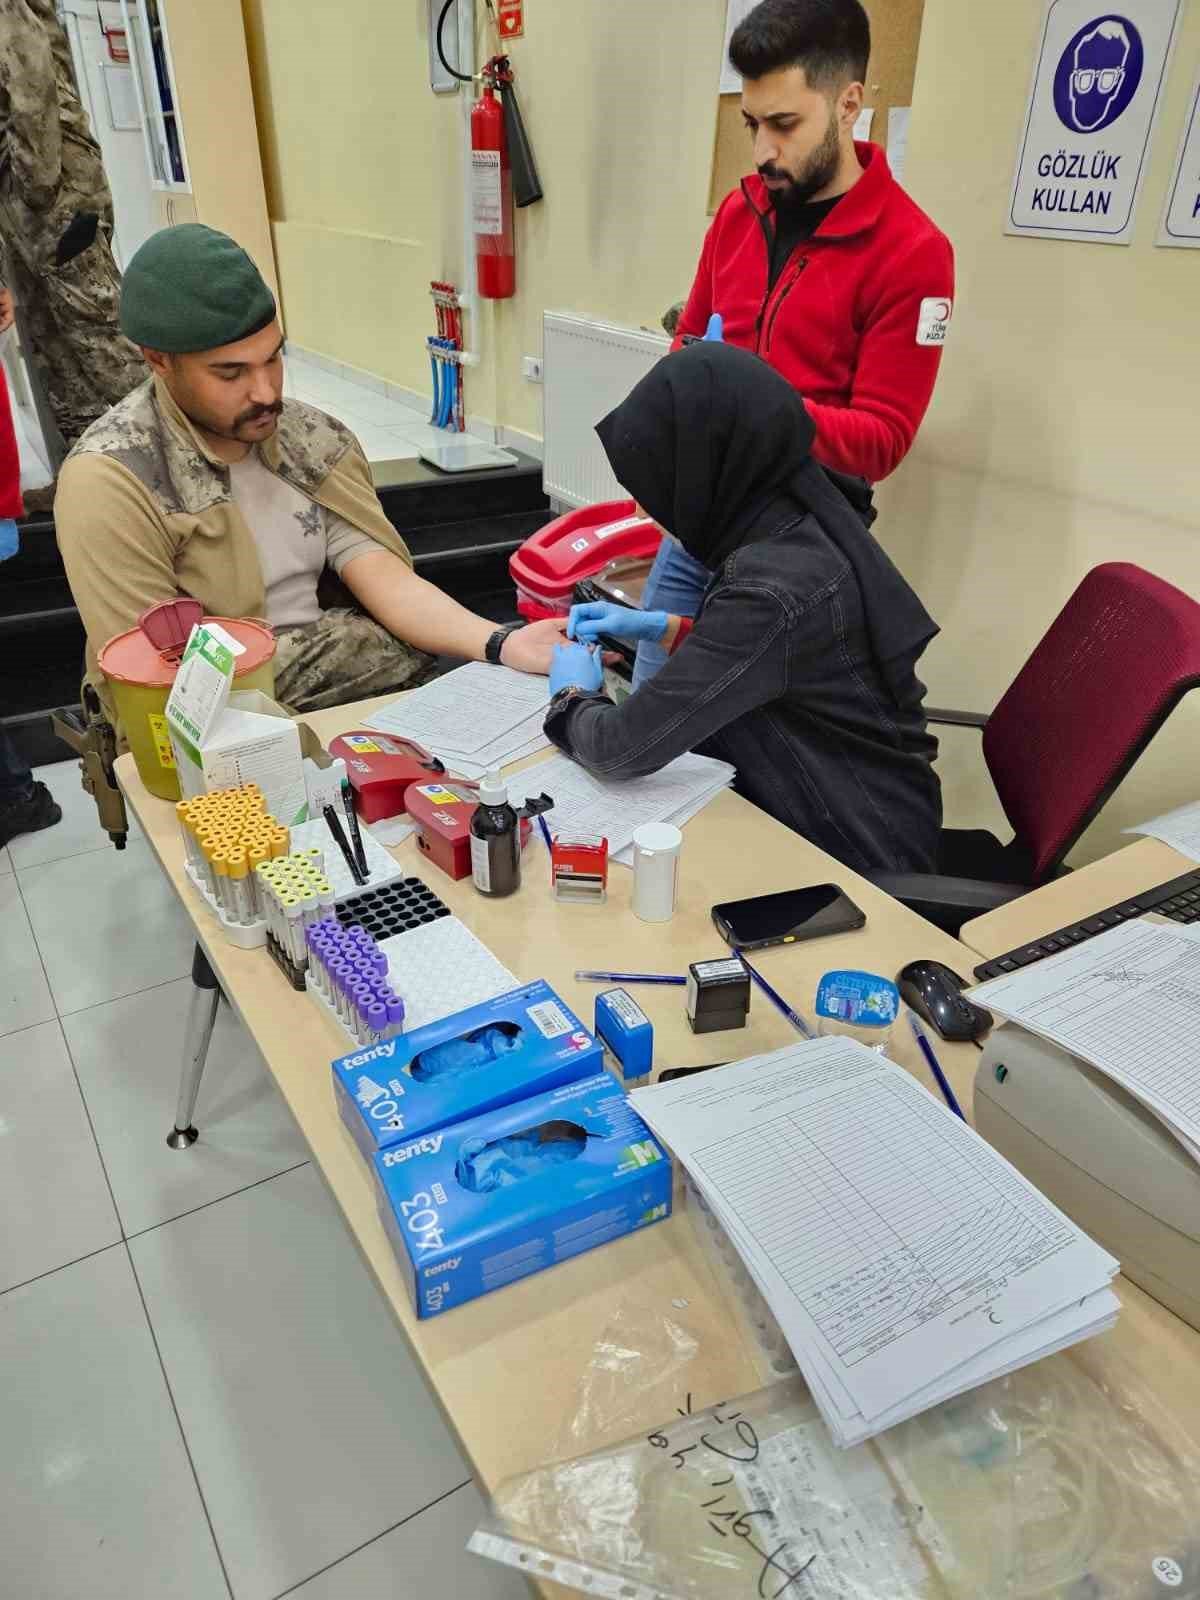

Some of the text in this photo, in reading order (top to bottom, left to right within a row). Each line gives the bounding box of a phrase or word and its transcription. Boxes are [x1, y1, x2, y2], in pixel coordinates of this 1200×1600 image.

[1037, 149, 1122, 180] GÖZLÜK
[1031, 188, 1112, 215] KULLAN
[571, 1031, 593, 1050] S
[342, 1041, 397, 1070] tenty
[382, 1134, 444, 1168] tenty
[629, 1139, 664, 1168] M
[400, 1191, 447, 1250] 403
[423, 1256, 462, 1278] tenty
